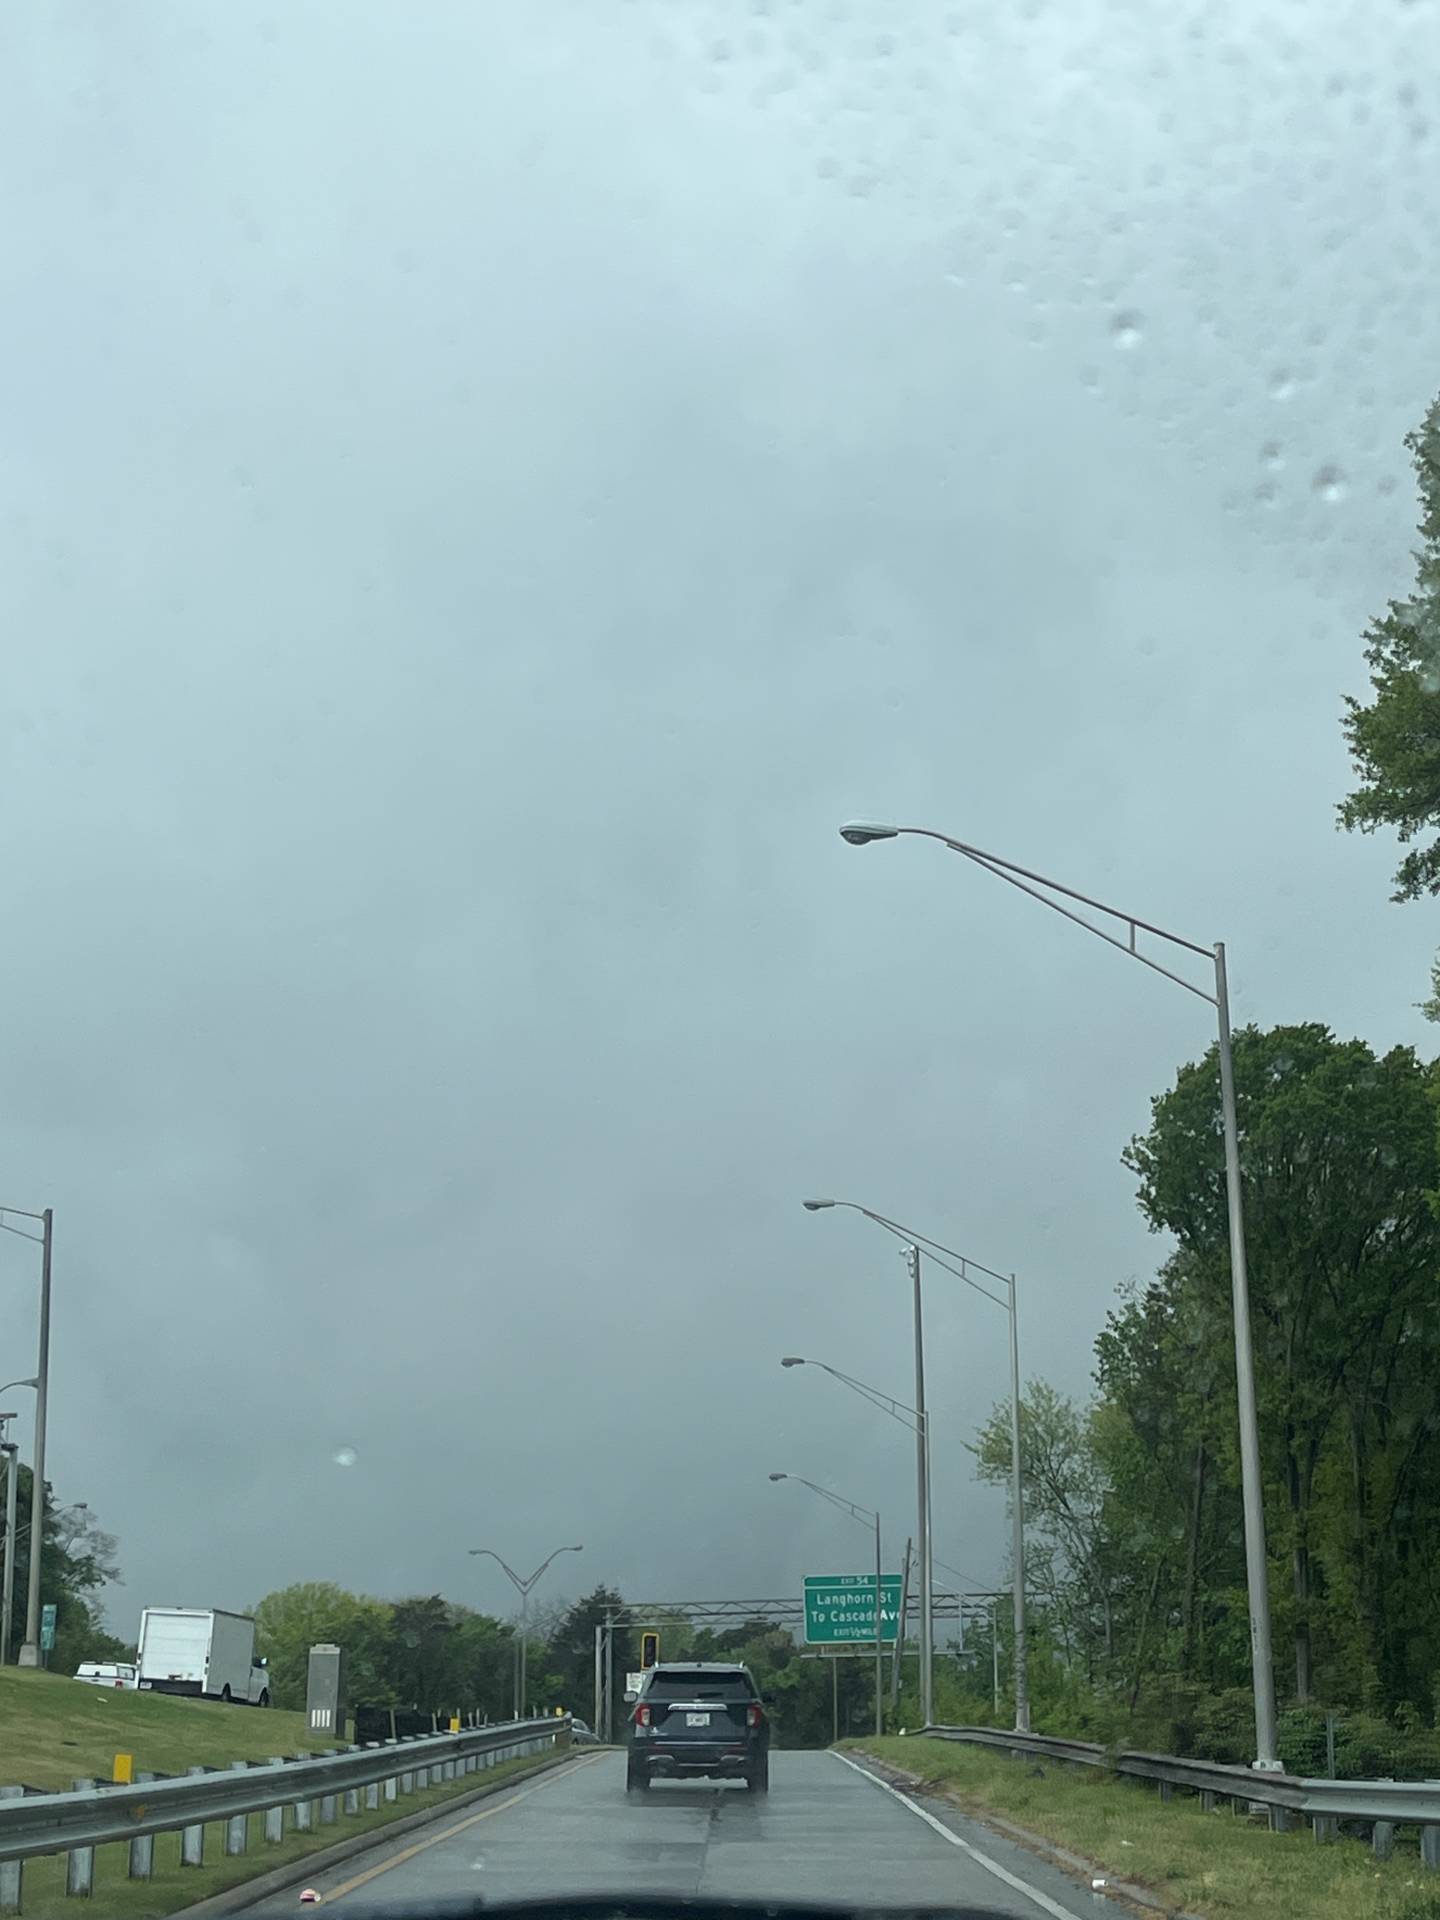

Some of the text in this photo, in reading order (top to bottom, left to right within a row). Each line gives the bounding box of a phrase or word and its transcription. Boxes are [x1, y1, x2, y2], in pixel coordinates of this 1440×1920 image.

[856, 1576, 868, 1585] 54
[817, 1592, 892, 1607] Langhorn St
[811, 1611, 826, 1623] To
